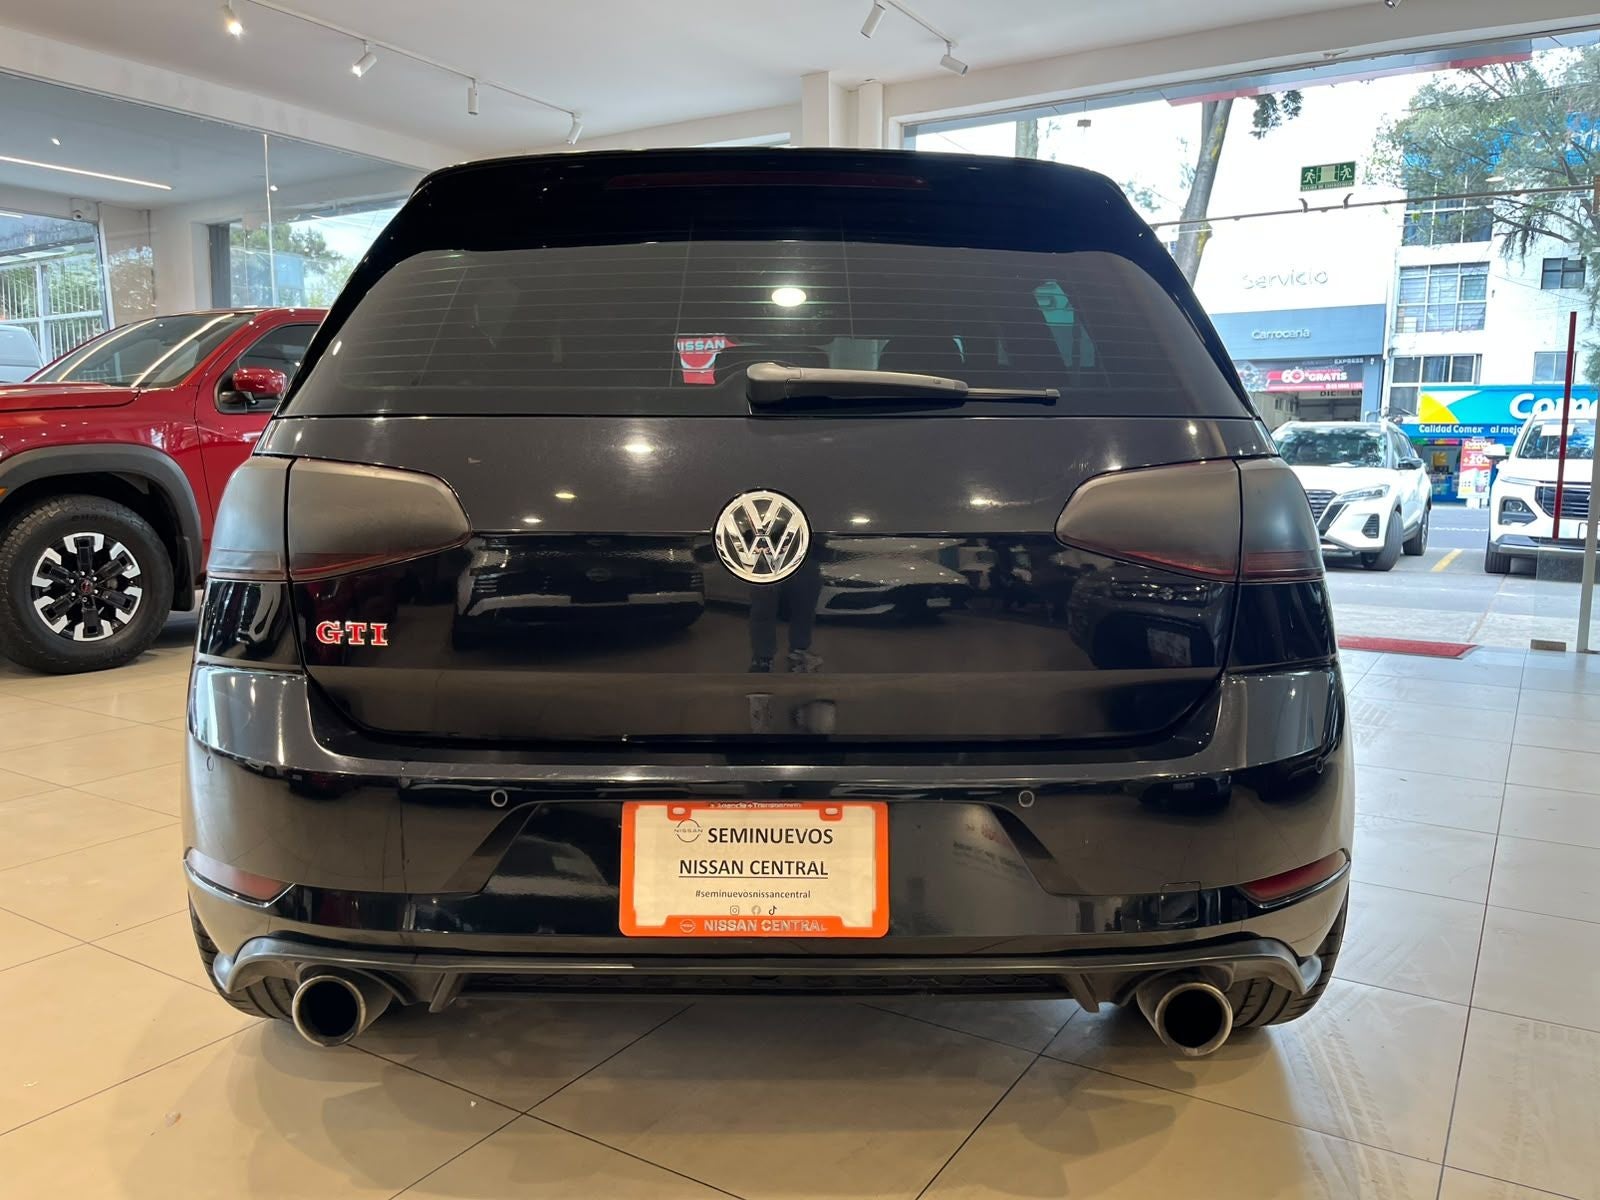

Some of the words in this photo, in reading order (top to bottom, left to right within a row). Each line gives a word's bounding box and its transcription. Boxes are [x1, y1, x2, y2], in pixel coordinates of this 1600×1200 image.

[1308, 372, 1348, 382] GRATIS
[1509, 393, 1597, 419] Com
[1419, 424, 1452, 433] Calidad
[1453, 424, 1482, 433] Comex
[1490, 425, 1499, 433] al
[316, 621, 388, 646] GTI
[707, 827, 834, 845] SEMINUEVOS
[679, 859, 744, 875] NISSAN
[749, 860, 829, 876] CENTRAL
[695, 889, 811, 899] #seminuevosnissancentral
[704, 919, 757, 932] NISSAN
[761, 919, 828, 932] CENTRAL
